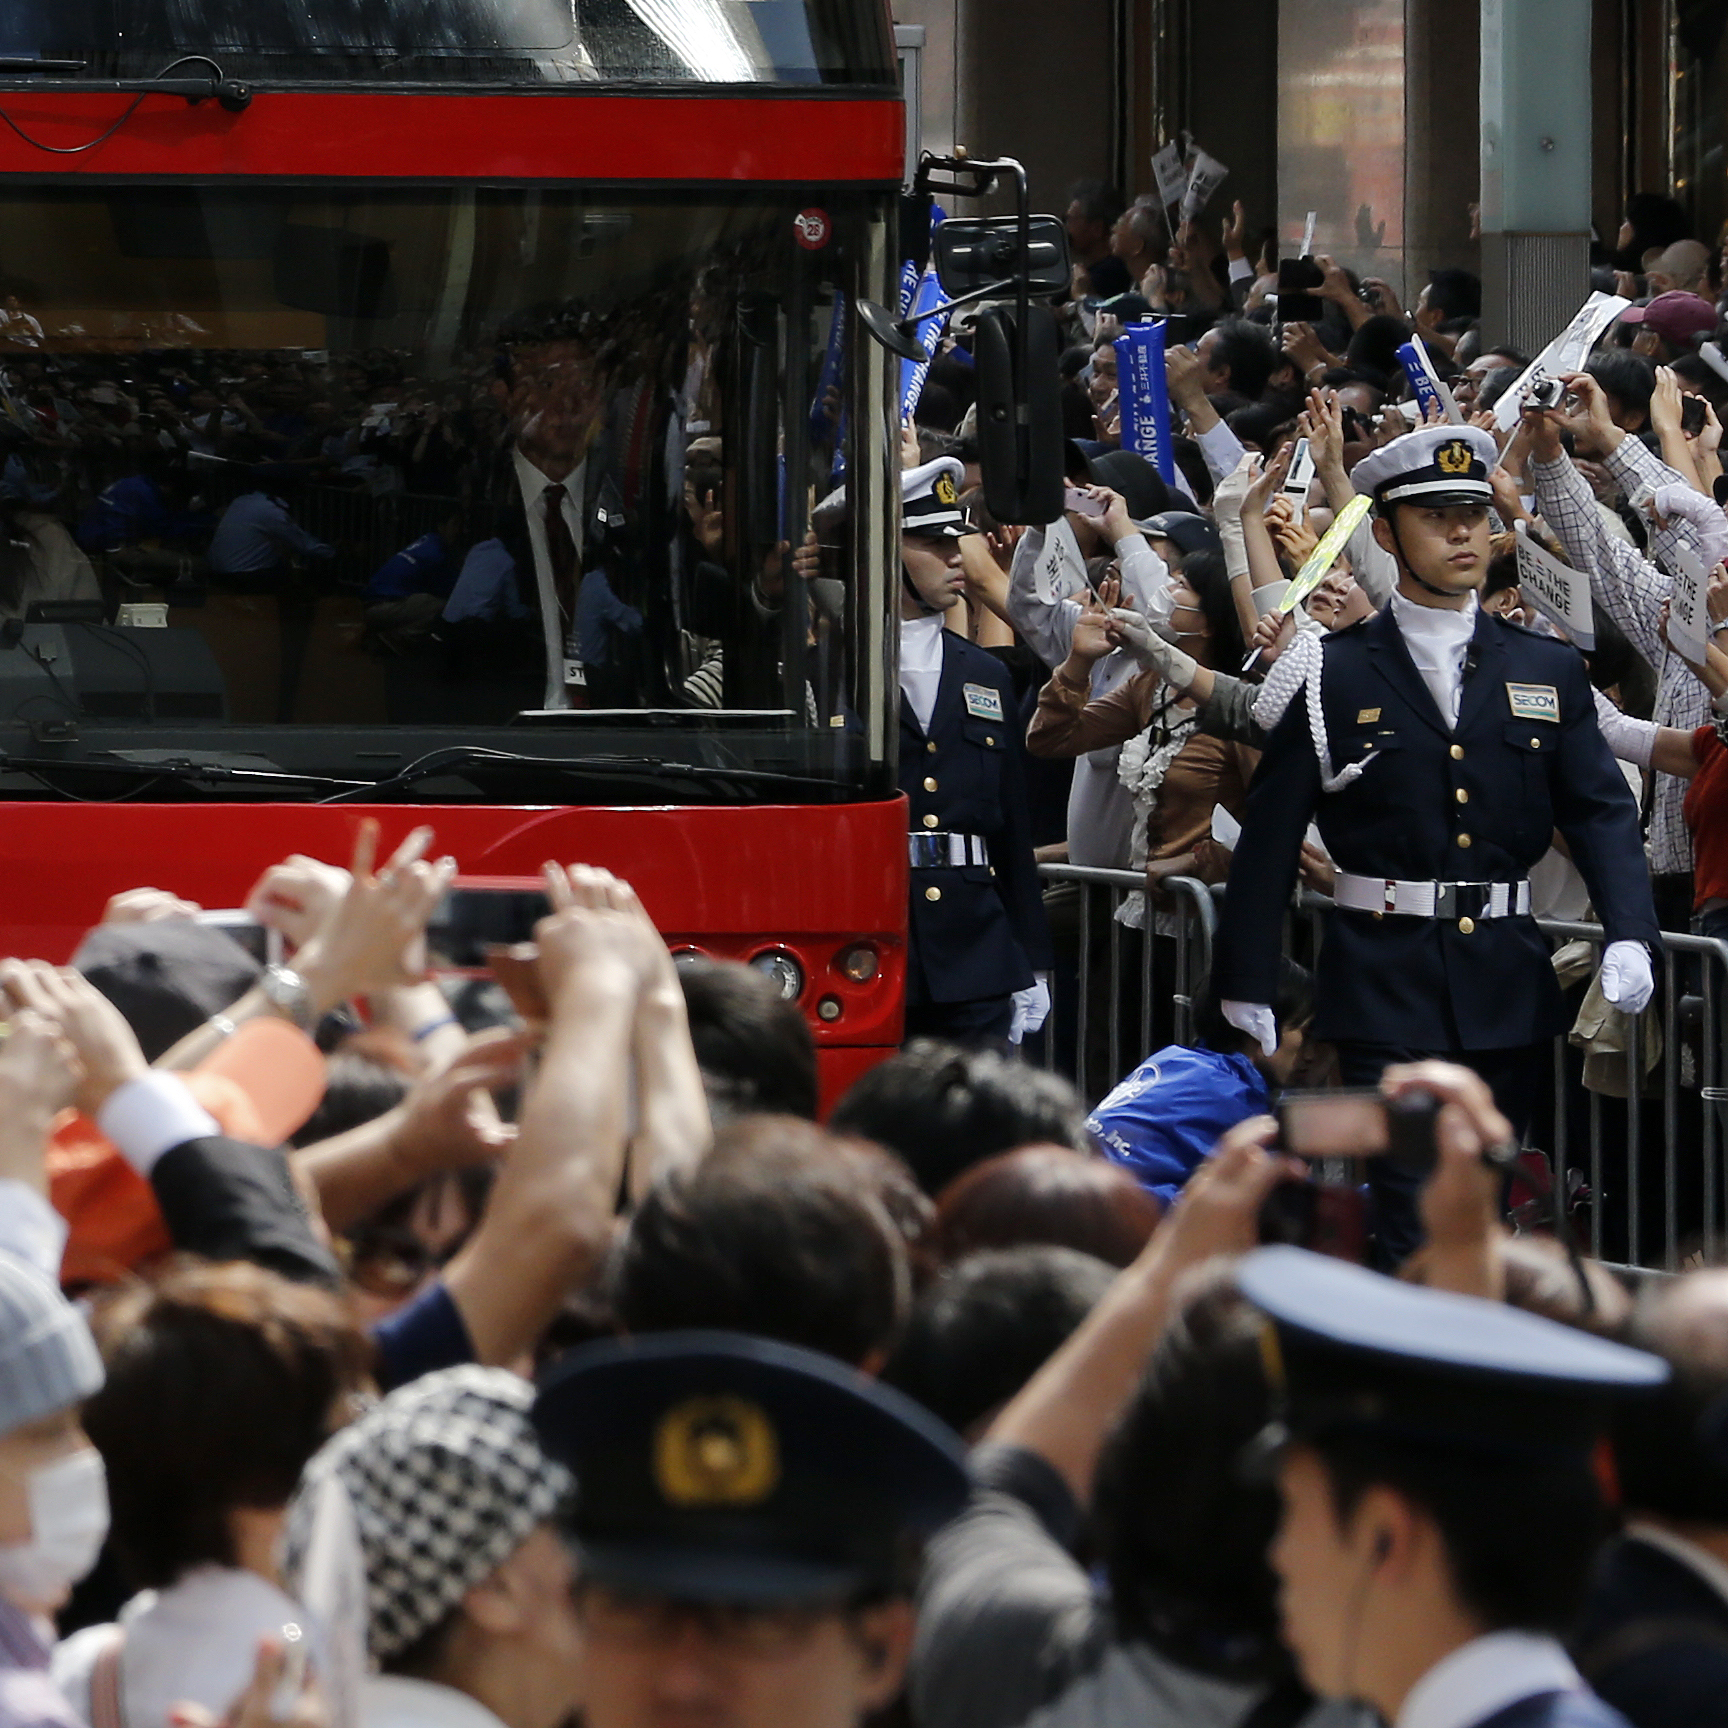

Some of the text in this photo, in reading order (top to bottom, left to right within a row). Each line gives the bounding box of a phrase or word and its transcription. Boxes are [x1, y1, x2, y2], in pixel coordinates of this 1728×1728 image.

[1415, 375, 1434, 395] BE
[1140, 415, 1160, 469] ANGE
[1518, 543, 1571, 599] BE THE
[1520, 564, 1571, 616] CHANGE
[1681, 573, 1698, 602] THE
[1513, 693, 1556, 710] SECOM
[1105, 1130, 1132, 1157] Inc.
